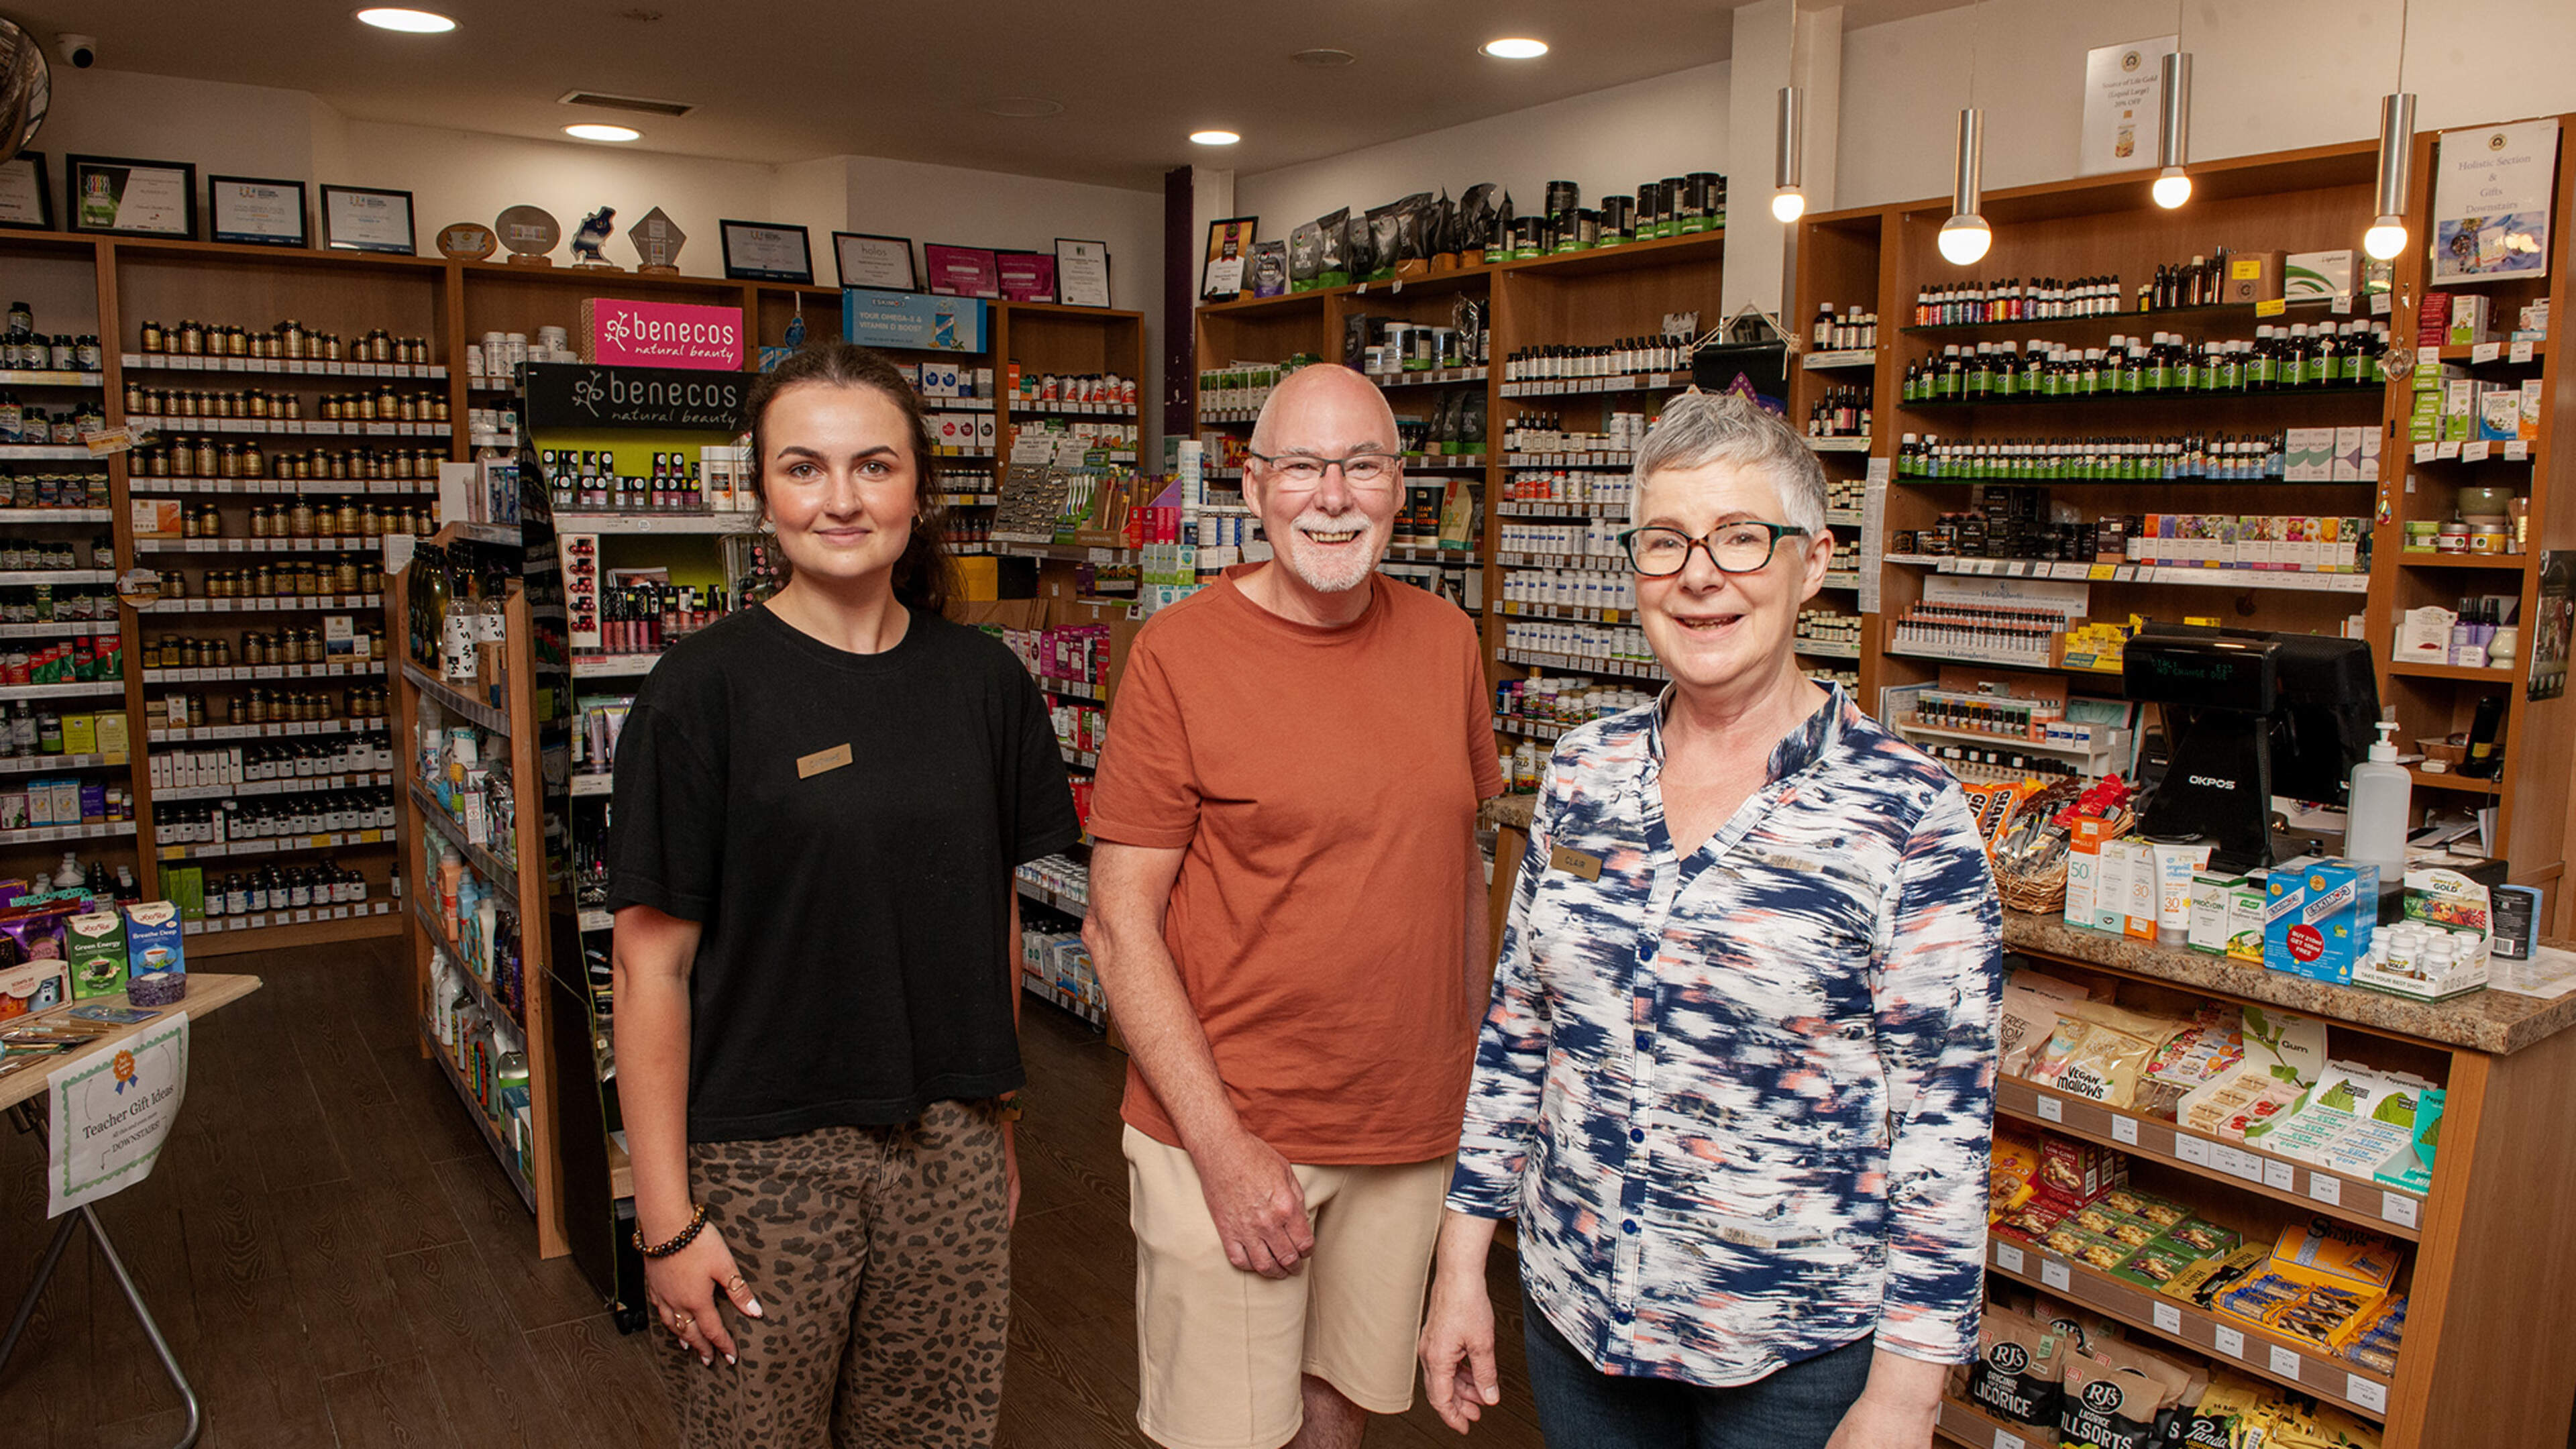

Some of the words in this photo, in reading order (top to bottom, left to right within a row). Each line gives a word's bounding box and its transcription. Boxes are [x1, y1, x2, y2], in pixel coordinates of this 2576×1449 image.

[2458, 160, 2494, 170] Holistic
[2496, 155, 2531, 166] Section
[2488, 173, 2496, 182] &
[2480, 189, 2503, 197] Gifts
[2465, 202, 2518, 214] Downstairs
[861, 244, 888, 257] holos
[859, 313, 879, 321] YOUR
[881, 313, 914, 323] OMEGA-3
[634, 311, 734, 345] benecos
[859, 322, 889, 331] VITAMIN
[898, 325, 922, 333] BOOST
[635, 343, 684, 356] natural
[690, 345, 734, 364] beauty
[610, 370, 737, 408] benecos
[612, 408, 674, 421] natural
[682, 410, 737, 430] beauty
[2189, 775, 2236, 790] OKPOS
[1982, 790, 2012, 841] GIANT
[1565, 856, 1586, 868] CLAIR
[2071, 862, 2089, 879] 50
[2133, 884, 2149, 898] 30
[2434, 883, 2458, 894] GOLD
[2165, 896, 2180, 908] 30
[159, 928, 177, 938] Deep
[2292, 931, 2304, 940] BUY
[97, 941, 121, 950] Energy
[2296, 947, 2312, 956] FREE
[2375, 975, 2392, 983] YOUR
[2393, 979, 2406, 987] BEST
[2407, 981, 2425, 990] SHOT!
[2002, 1013, 2031, 1030] FREE
[2256, 1032, 2279, 1046] True
[2282, 1040, 2308, 1054] Gum
[2068, 1065, 2100, 1085] VEGAN
[2332, 1063, 2373, 1078] Peppersmith
[2385, 1076, 2428, 1090] Peppersmith
[82, 1110, 127, 1139] Teacher
[129, 1096, 150, 1116] Gift
[150, 1084, 174, 1105] Ideas
[1994, 1345, 2024, 1367] RJ's
[1974, 1379, 2032, 1418] LICORICE
[2087, 1384, 2118, 1405] RJ's
[2079, 1409, 2110, 1428] LICORICE
[2184, 1419, 2228, 1448] Panda
